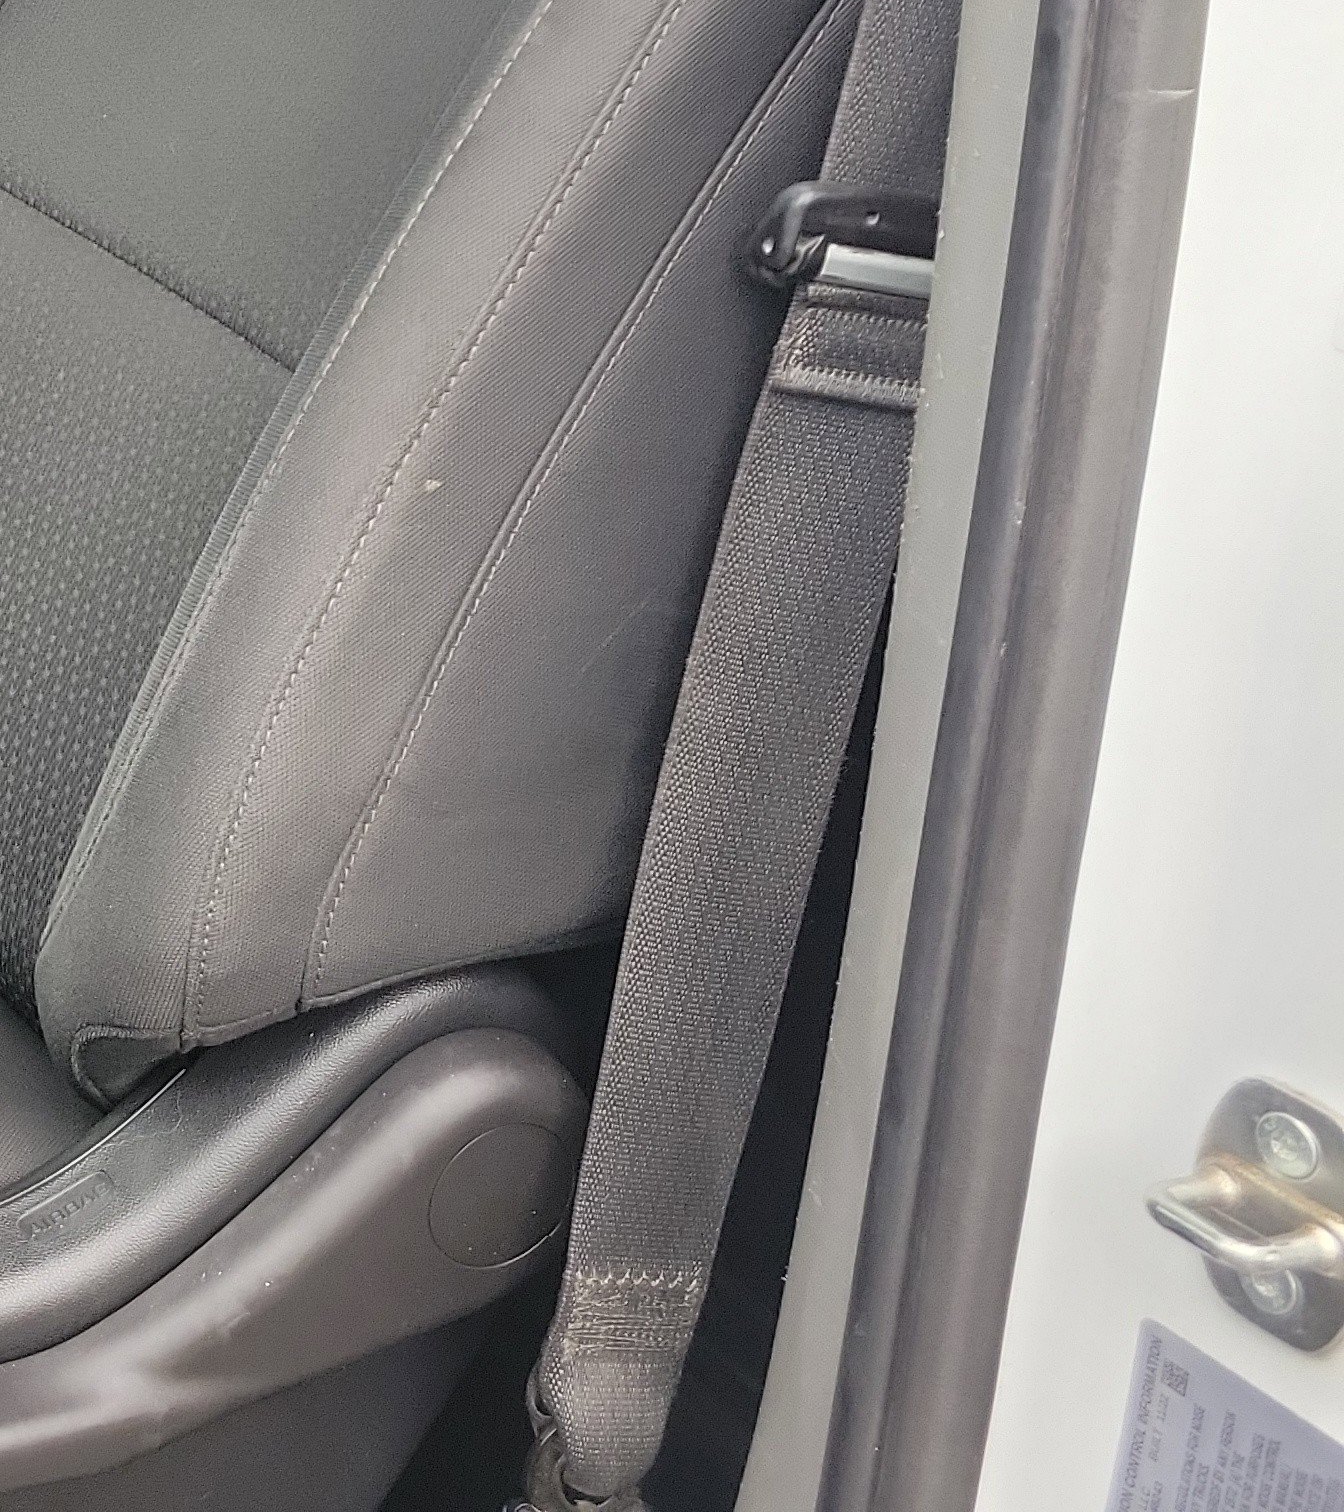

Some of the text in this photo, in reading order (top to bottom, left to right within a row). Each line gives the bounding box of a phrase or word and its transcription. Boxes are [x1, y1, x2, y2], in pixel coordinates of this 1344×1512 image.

[31, 1182, 109, 1236] AIRBAG
[1124, 1426, 1146, 1489] CONTROL
[1138, 1335, 1162, 1423] INFORMATION
